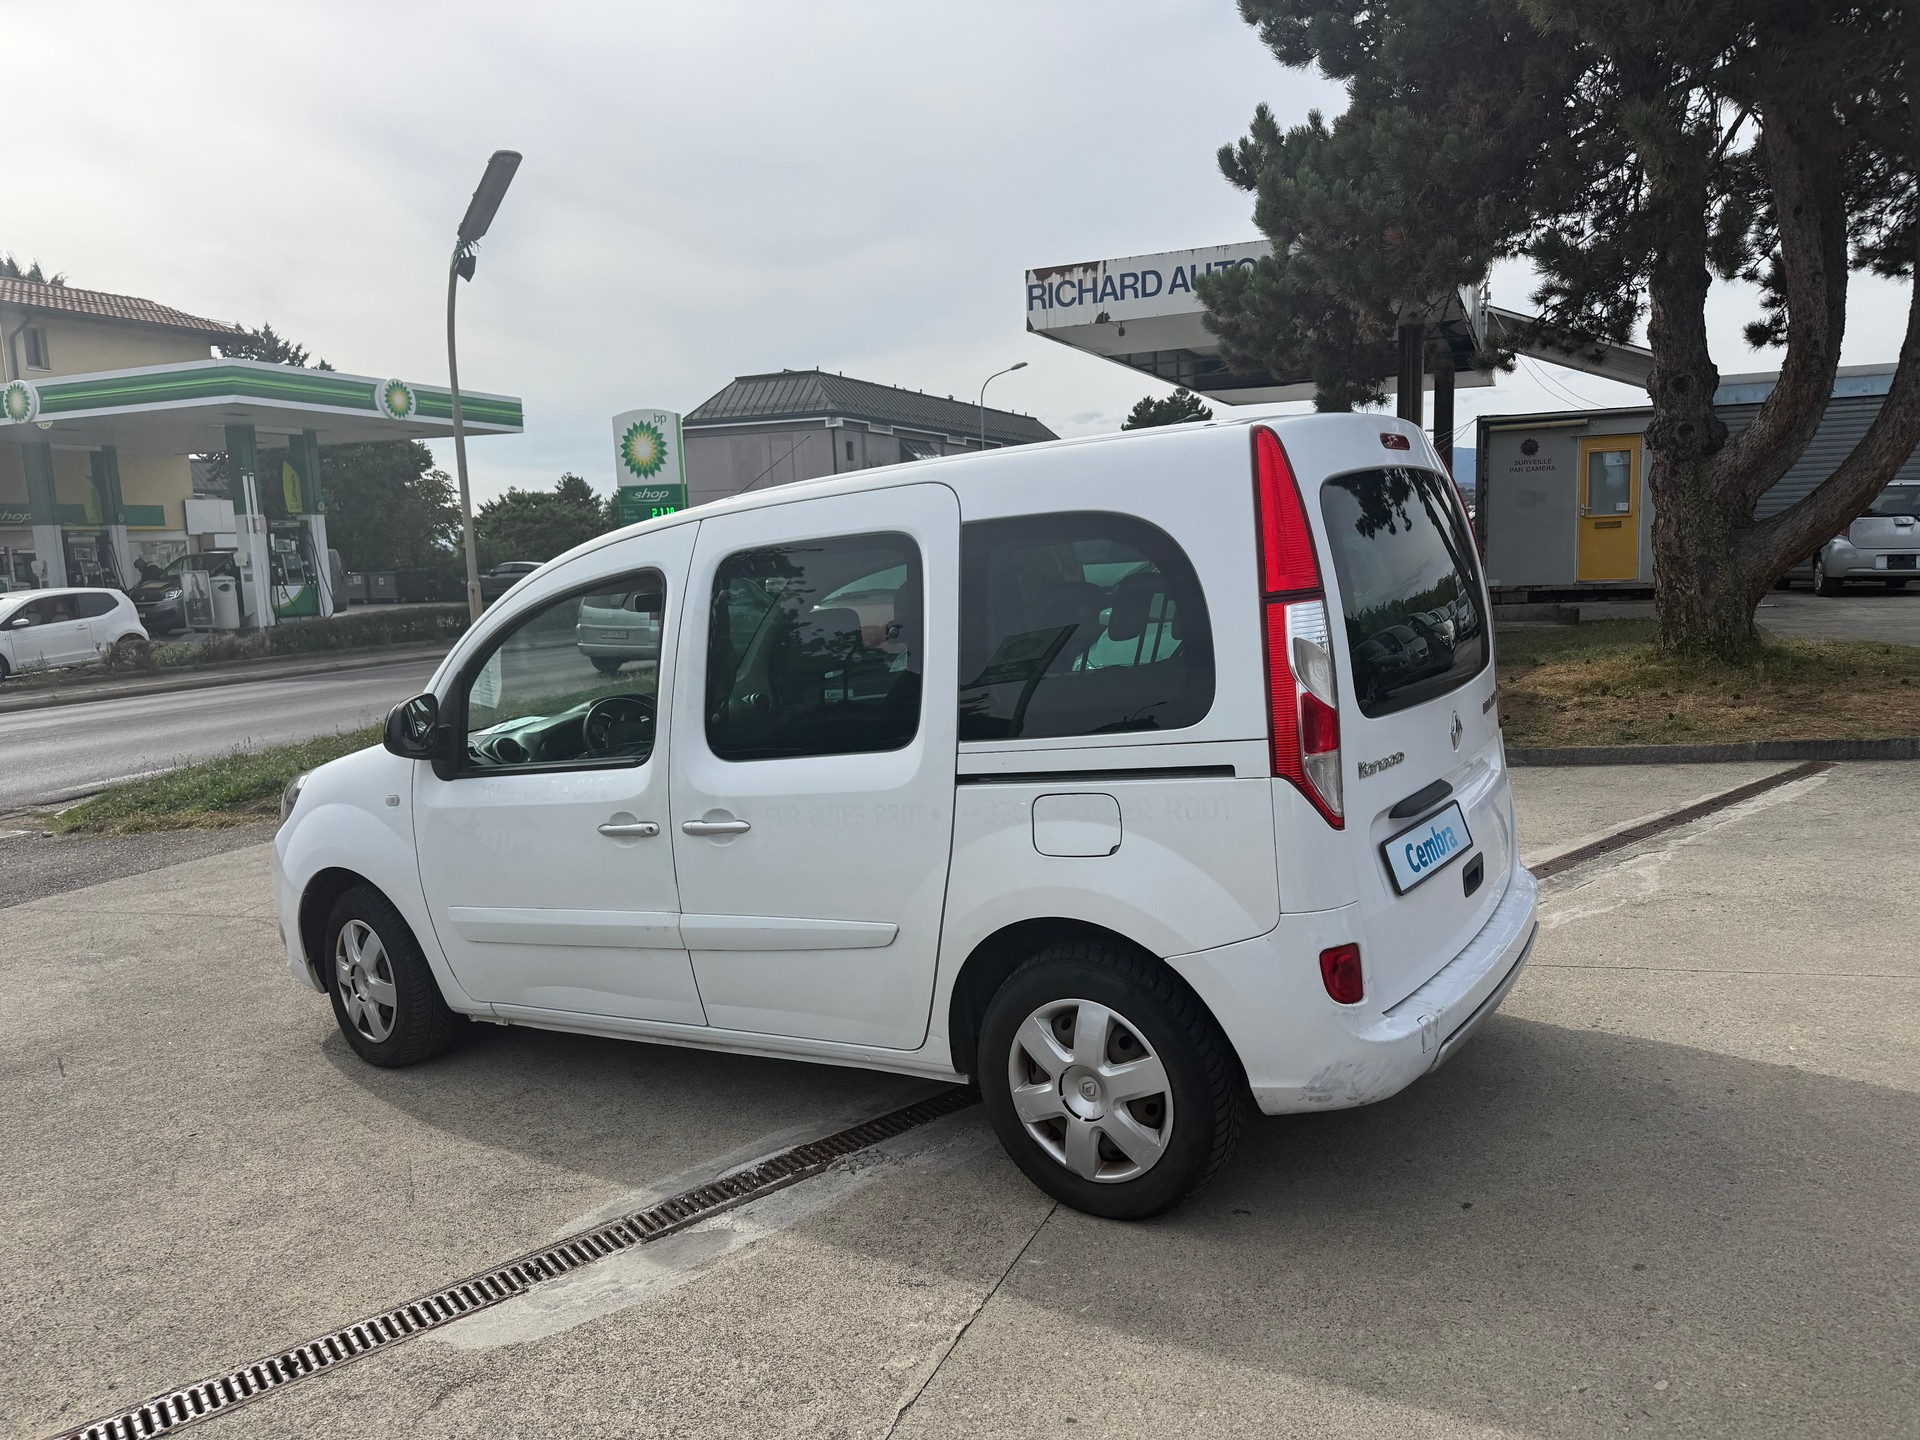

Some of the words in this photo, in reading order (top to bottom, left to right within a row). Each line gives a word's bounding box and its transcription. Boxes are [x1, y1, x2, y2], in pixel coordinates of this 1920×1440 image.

[1028, 269, 1163, 311] RICHARD
[653, 413, 667, 425] bp
[1509, 466, 1524, 474] PAR
[634, 488, 669, 503] shop
[0, 510, 33, 524] hop
[1405, 826, 1458, 873] Cembra
